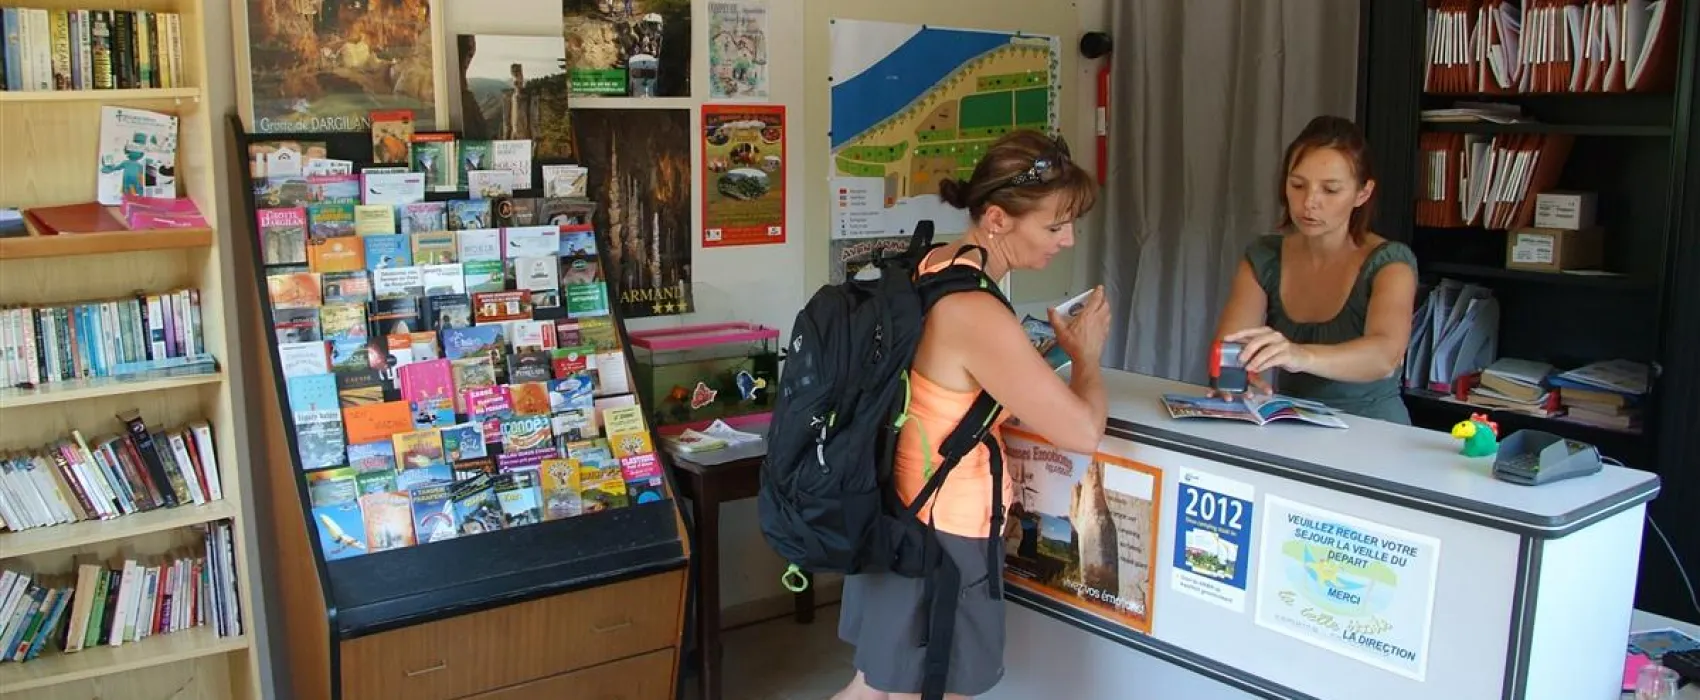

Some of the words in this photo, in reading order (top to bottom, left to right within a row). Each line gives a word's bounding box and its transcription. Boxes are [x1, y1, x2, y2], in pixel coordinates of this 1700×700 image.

[260, 117, 293, 132] Grotte
[295, 119, 309, 130] de
[311, 116, 371, 131] DARGILAN
[620, 286, 684, 303] ARMAND
[1185, 488, 1243, 530] 2012
[1288, 513, 1334, 534] VEUILLEZ
[1336, 527, 1378, 547] REGLER
[1381, 539, 1418, 558] VOTRE
[1295, 528, 1335, 547] SEJOUR
[1337, 541, 1350, 551] LA
[1352, 544, 1389, 562] VEILLE
[1391, 555, 1407, 568] DU
[1328, 550, 1368, 569] DEPART
[1086, 587, 1100, 599] vos
[1327, 587, 1361, 605] MERCI
[1342, 629, 1356, 641] LA
[1358, 635, 1416, 661] DIRECTION
